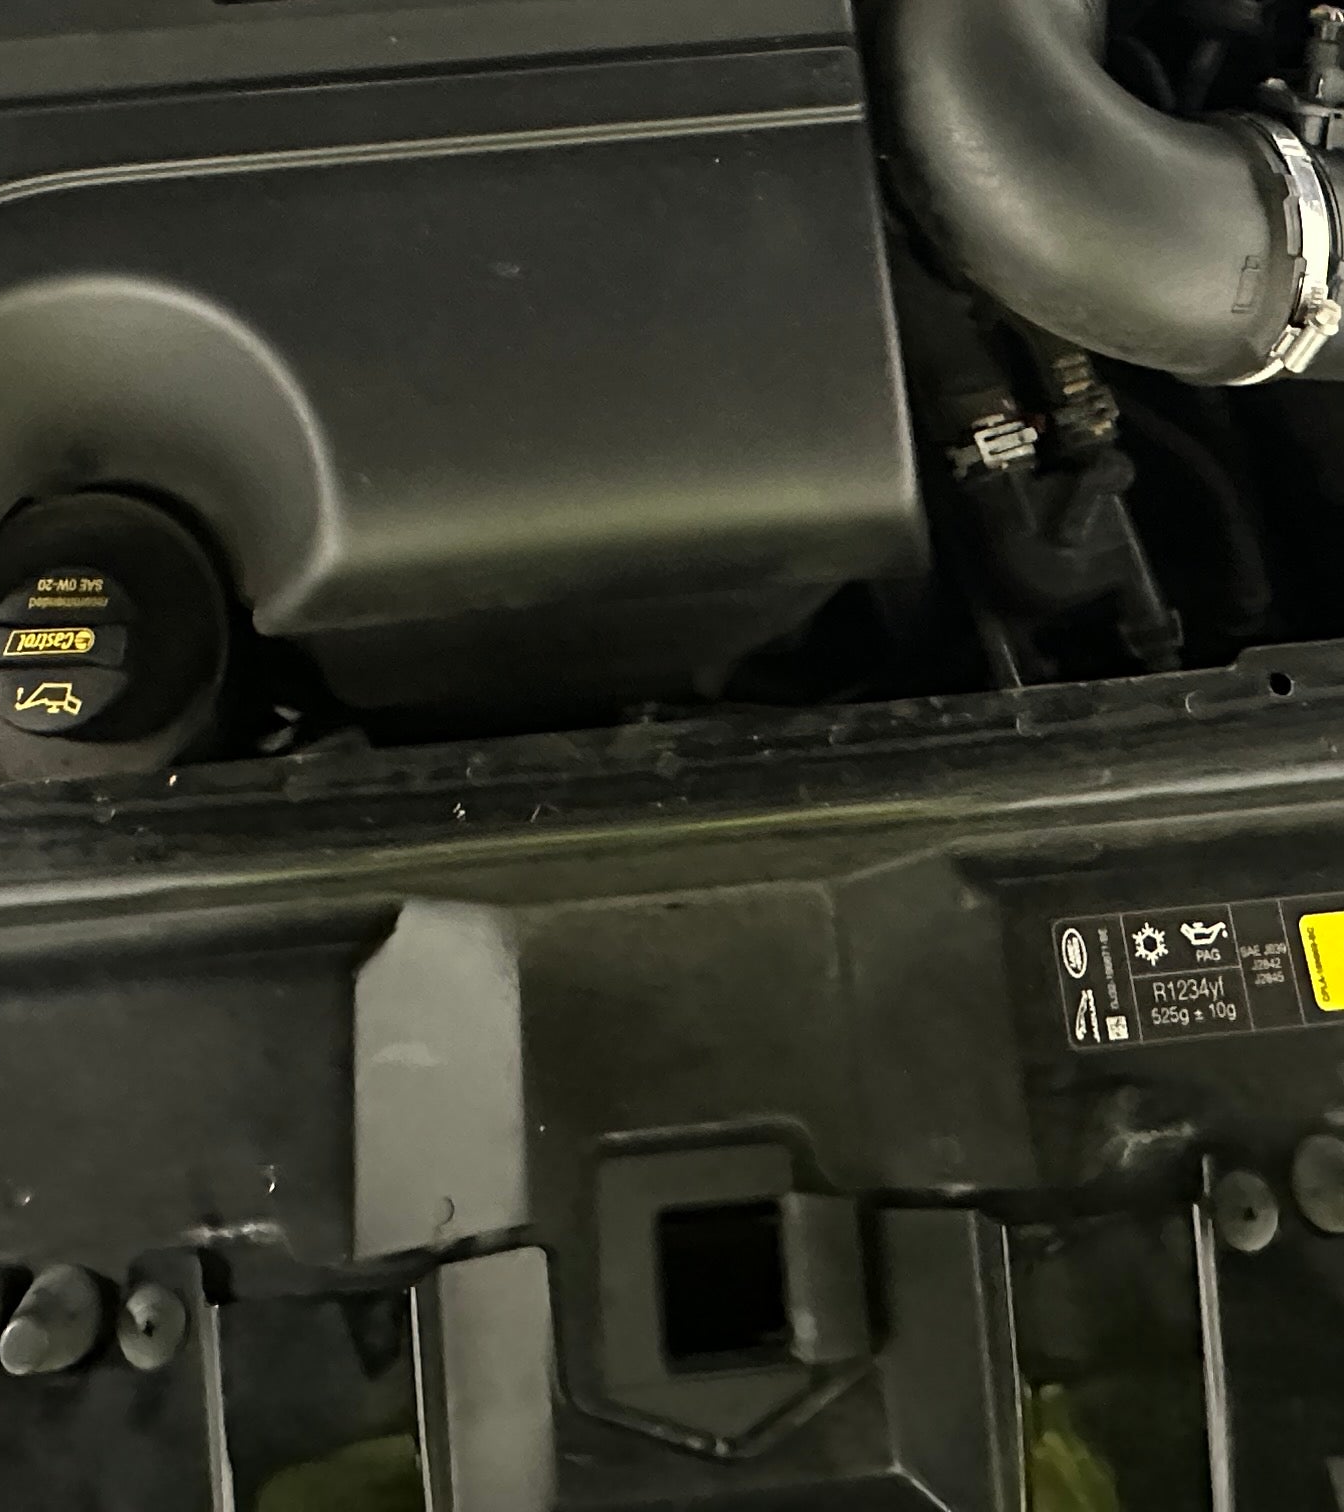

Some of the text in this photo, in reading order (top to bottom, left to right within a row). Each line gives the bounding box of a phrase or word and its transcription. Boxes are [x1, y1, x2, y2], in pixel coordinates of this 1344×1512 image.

[37, 578, 104, 592] SAE 0W-20
[16, 632, 75, 651] Castrol
[1196, 949, 1222, 962] PAG
[1152, 975, 1225, 1003] R1234yf
[1208, 1001, 1237, 1022] 10g
